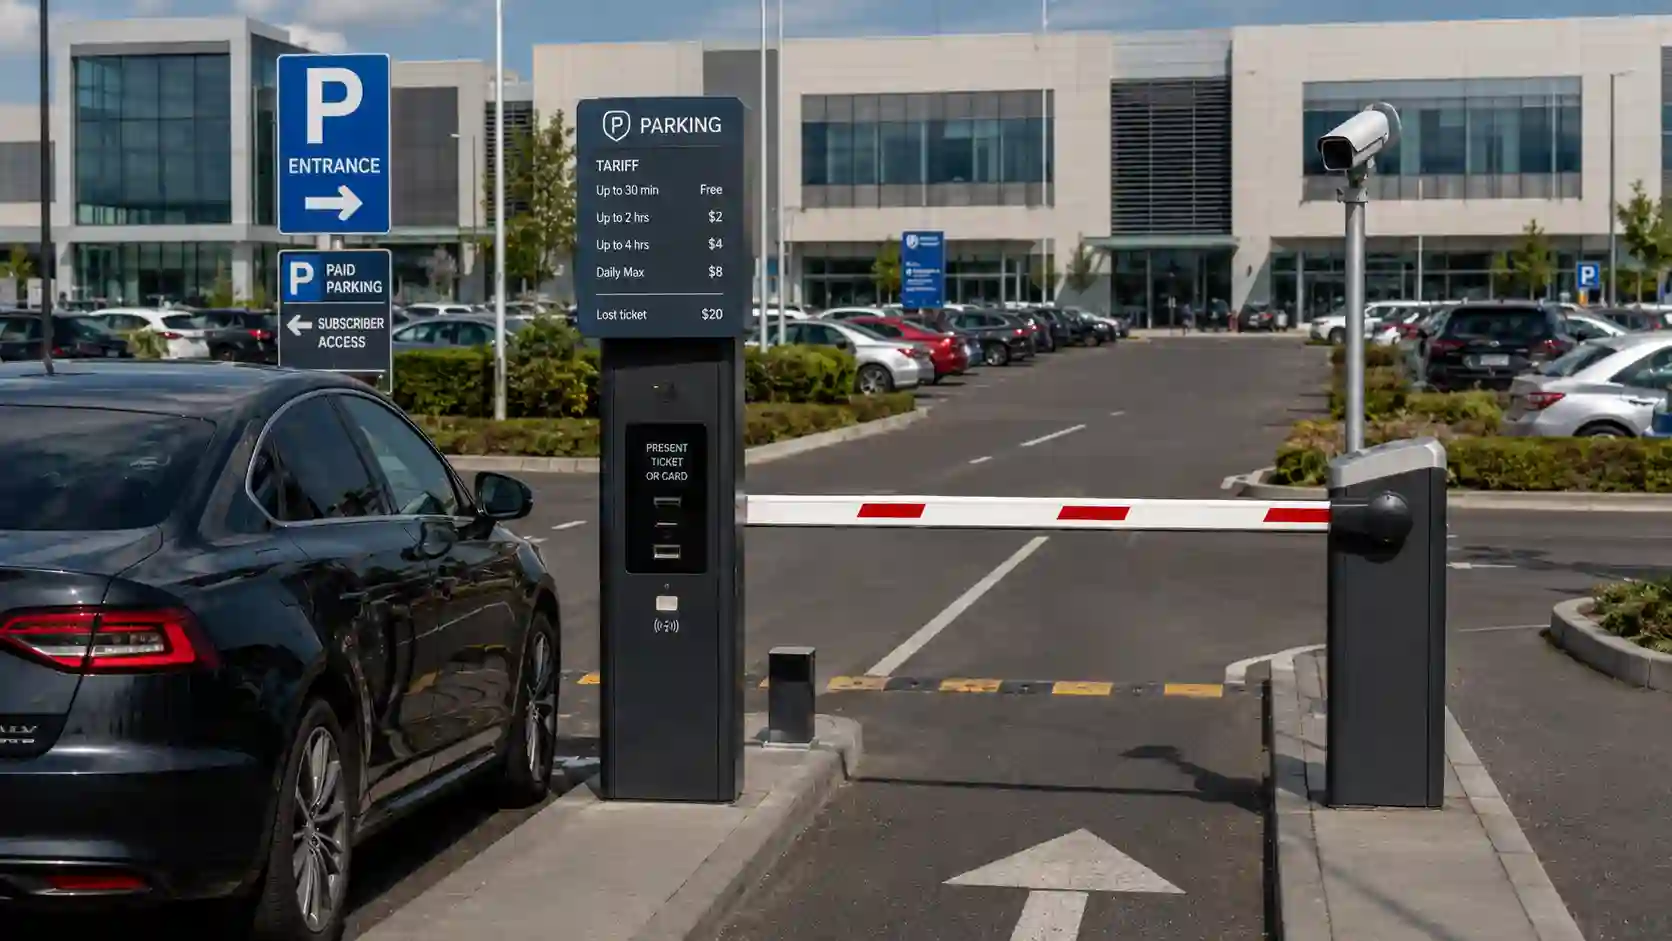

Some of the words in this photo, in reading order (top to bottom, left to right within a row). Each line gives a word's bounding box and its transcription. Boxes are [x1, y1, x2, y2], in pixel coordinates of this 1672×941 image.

[306, 67, 363, 144] P
[611, 116, 624, 134] P
[640, 116, 722, 134] PARKING
[288, 158, 381, 174] ENTRANCE
[596, 159, 640, 172] TARIFF
[596, 185, 609, 198] Up
[612, 186, 623, 196] to
[625, 185, 638, 196] 30
[640, 185, 660, 196] min
[700, 184, 723, 195] Free
[596, 212, 609, 225] Up
[612, 213, 623, 223] to
[625, 212, 632, 223] 2
[634, 212, 650, 223] hrs
[708, 210, 723, 223] $2
[596, 239, 609, 252] Up
[612, 240, 623, 250] to
[625, 239, 632, 250] 4
[634, 239, 650, 250] hrs
[708, 237, 723, 250] $4
[326, 263, 356, 277] PAID
[596, 266, 621, 280] Daily
[623, 267, 645, 278] Max
[708, 265, 723, 279] $8
[1581, 266, 1595, 285] P
[290, 261, 314, 296] P
[326, 280, 383, 294] PARKING
[596, 309, 617, 320] Lost
[620, 309, 648, 320] ticket
[701, 308, 723, 321] $20
[318, 317, 385, 330] SUBSCRIBER
[318, 336, 366, 349] ACCESS
[646, 443, 688, 453] PRESENT
[651, 457, 684, 467] TICKET
[646, 471, 660, 481] OR
